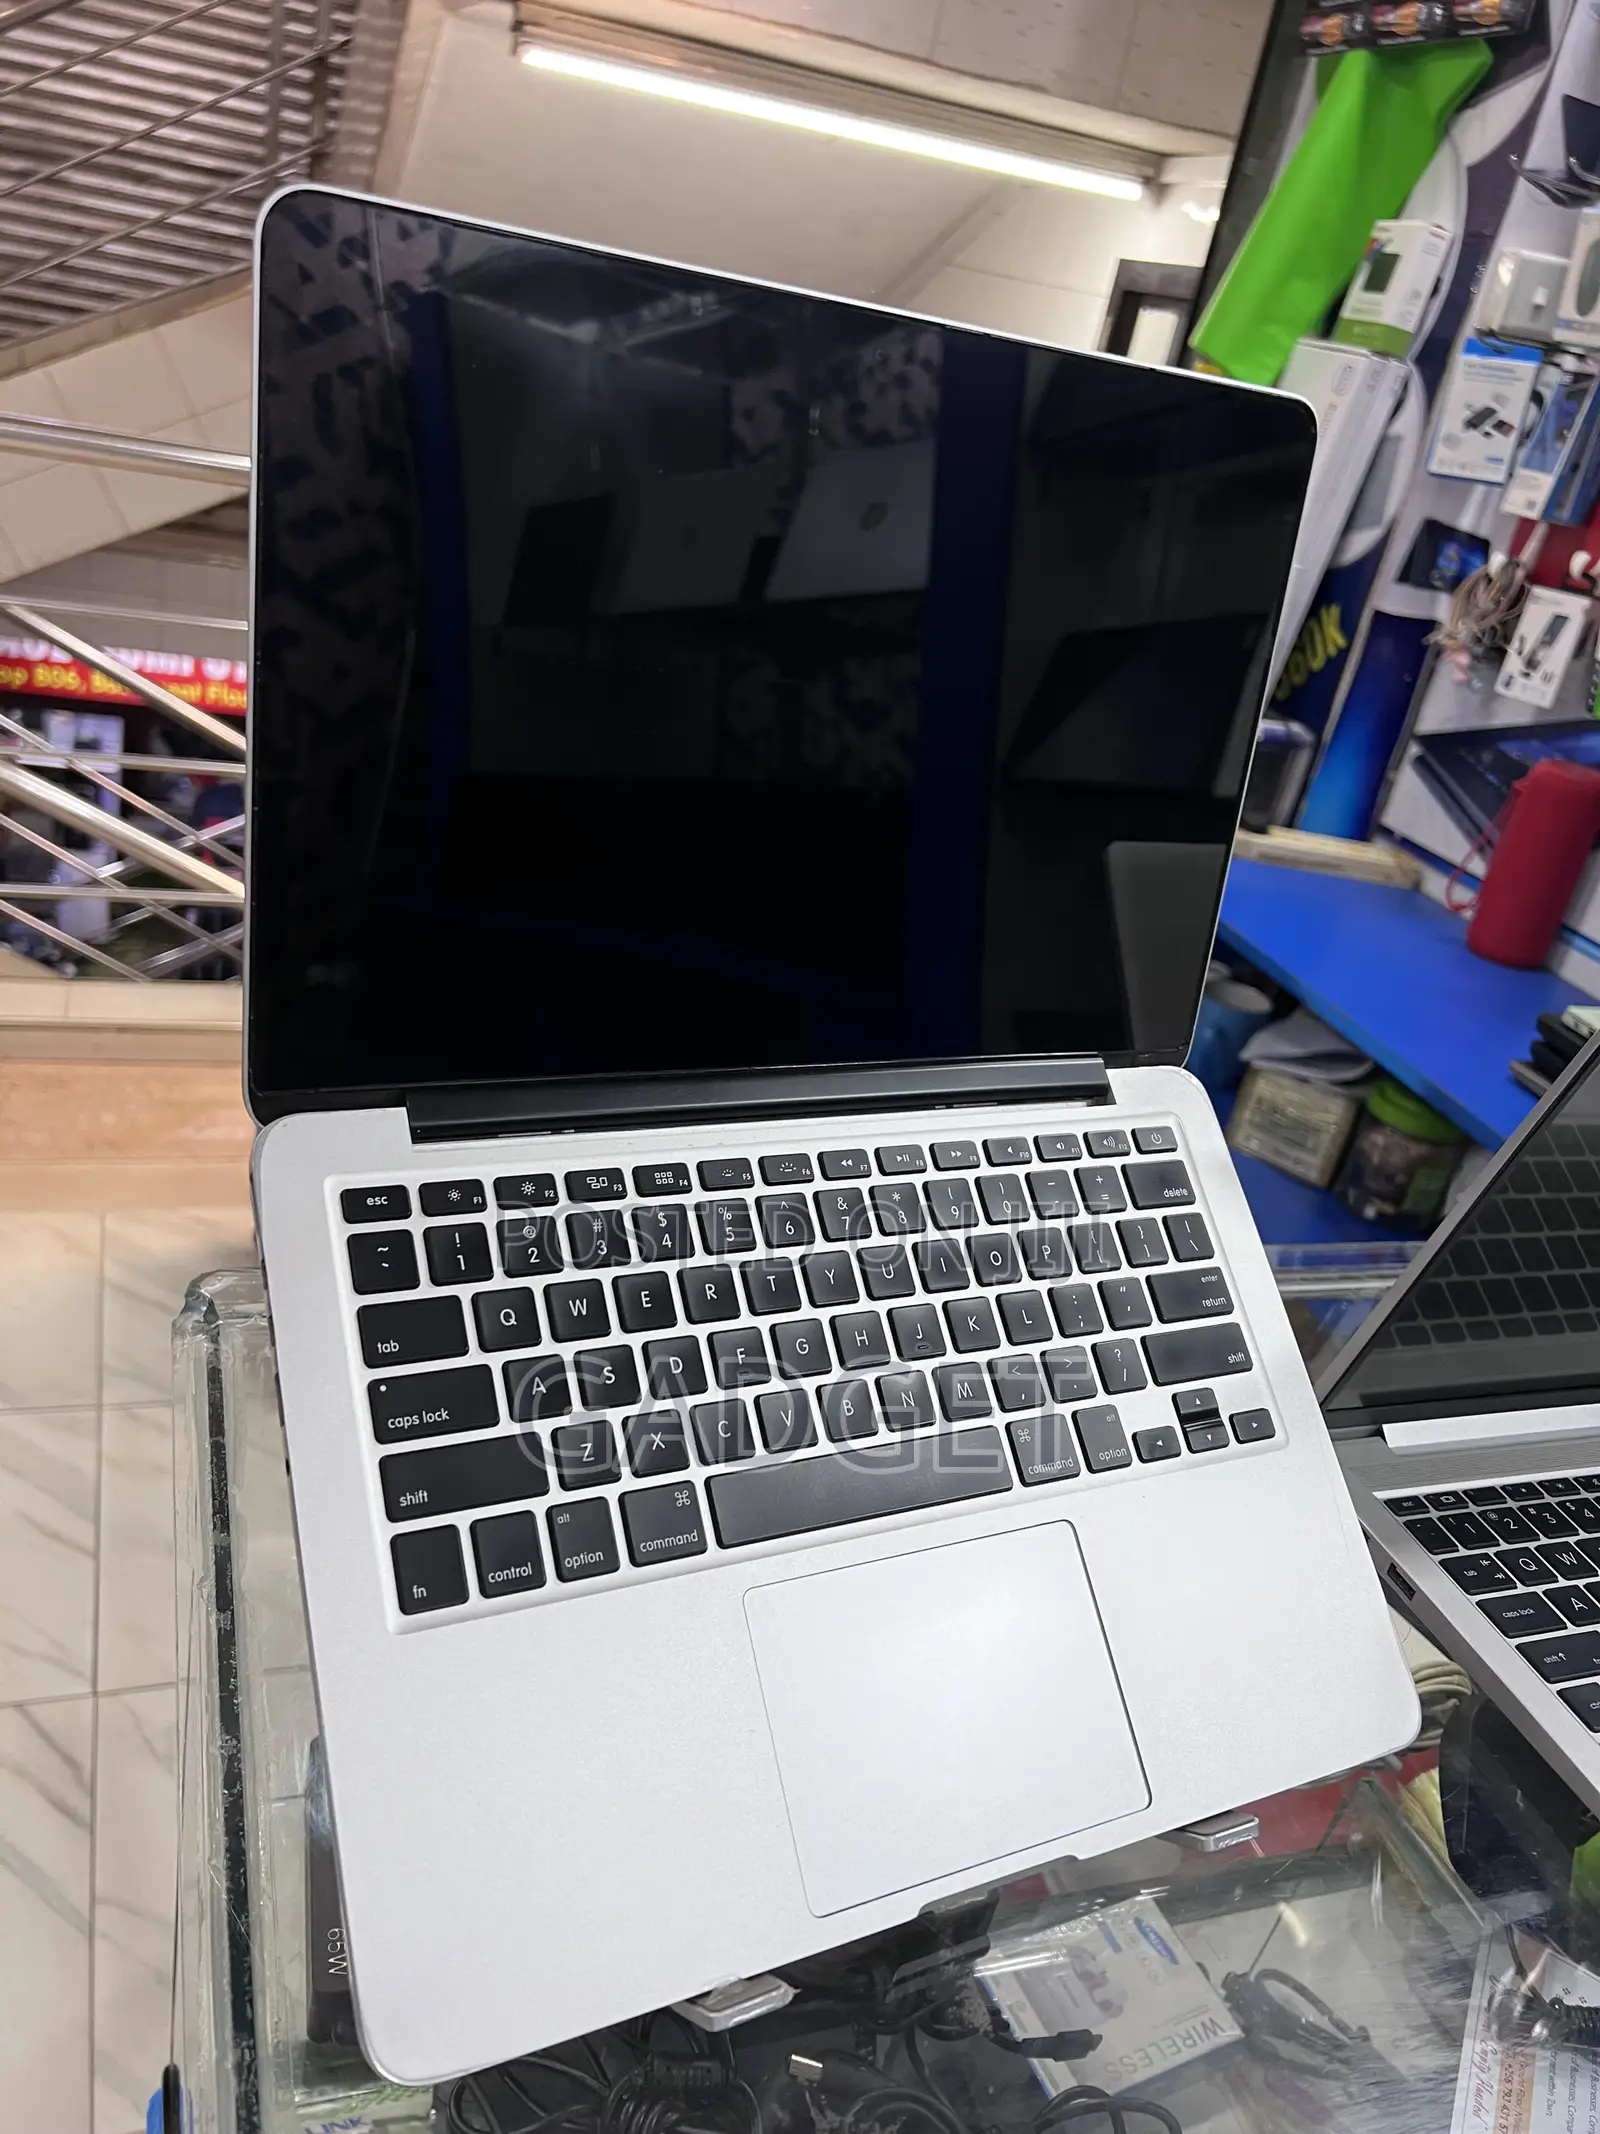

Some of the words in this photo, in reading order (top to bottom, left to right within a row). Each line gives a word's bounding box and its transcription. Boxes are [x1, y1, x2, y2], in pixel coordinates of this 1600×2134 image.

[860, 1164, 868, 1172] F7
[679, 1179, 688, 1187] F4
[742, 1173, 751, 1181] F5
[1094, 1175, 1104, 1184] +
[544, 1189, 555, 1198] F2
[613, 1184, 623, 1192] F3
[948, 1187, 954, 1200] (
[998, 1181, 1005, 1195] )
[1163, 1187, 1189, 1198] delete
[366, 1194, 388, 1206] esc
[473, 1196, 483, 1204] F1
[837, 1196, 848, 1210] &
[1002, 1200, 1012, 1214] 0
[657, 1211, 667, 1228] $
[718, 1206, 732, 1221] %
[897, 1210, 907, 1224] 8
[951, 1205, 960, 1219] 9
[592, 1218, 603, 1233] #
[785, 1220, 795, 1235] 6
[841, 1216, 850, 1230] 7
[454, 1231, 461, 1248] !
[522, 1225, 537, 1239] @
[725, 1227, 735, 1241] 5
[597, 1240, 608, 1255] 3
[662, 1233, 672, 1248] 4
[527, 1248, 540, 1263] 2
[990, 1250, 1002, 1266] O
[1041, 1245, 1051, 1260] P
[457, 1255, 465, 1271] 1
[824, 1269, 835, 1285] Y
[882, 1263, 895, 1279] U
[766, 1275, 776, 1292] T
[1200, 1274, 1219, 1284] enter
[705, 1283, 717, 1300] R
[640, 1291, 652, 1308] E
[1202, 1296, 1227, 1308] return
[569, 1298, 587, 1317] W
[500, 1308, 517, 1326] Q
[967, 1315, 980, 1332] K
[1021, 1309, 1033, 1325] L
[855, 1330, 869, 1347] H
[916, 1323, 923, 1339] J
[377, 1341, 400, 1354] tab
[796, 1338, 809, 1354] G
[736, 1348, 745, 1365] F
[1227, 1352, 1246, 1364] shift
[668, 1356, 683, 1374] D
[602, 1366, 616, 1384] S
[532, 1376, 547, 1395] A
[957, 1382, 973, 1399] M
[901, 1390, 915, 1408] N
[842, 1400, 855, 1416] B
[387, 1413, 420, 1430] caps
[422, 1407, 450, 1423] lock
[780, 1409, 792, 1427] V
[1106, 1413, 1115, 1423] alt
[717, 1420, 731, 1438] C
[650, 1431, 665, 1451] X
[580, 1442, 595, 1462] Z
[1099, 1447, 1128, 1462] option
[1028, 1457, 1074, 1475] command
[399, 1490, 429, 1507] shift
[1528, 1507, 1537, 1515] #
[1566, 1502, 1576, 1511] $
[1584, 1508, 1595, 1519] 4
[557, 1513, 570, 1524] alt
[1486, 1511, 1499, 1521] @
[1504, 1518, 1518, 1529] 2
[1542, 1512, 1557, 1524] 3
[1465, 1523, 1476, 1534] 1
[640, 1529, 699, 1552] command
[564, 1550, 604, 1569] option
[1519, 1557, 1538, 1571] Q
[1555, 1551, 1578, 1566] W
[488, 1562, 533, 1583] control
[1464, 1570, 1478, 1578] tab
[412, 1585, 427, 1600] fn
[1570, 1597, 1589, 1611] A
[1502, 1609, 1520, 1619] caps
[1519, 1607, 1536, 1616] lock
[1543, 1653, 1560, 1664] shift
[327, 1927, 348, 1974] 65W
[1103, 2016, 1226, 2082] WIRELESS
[1472, 2040, 1498, 2078] Empty
[1502, 2086, 1513, 2104] 793
[1499, 2103, 1512, 2122] 431
